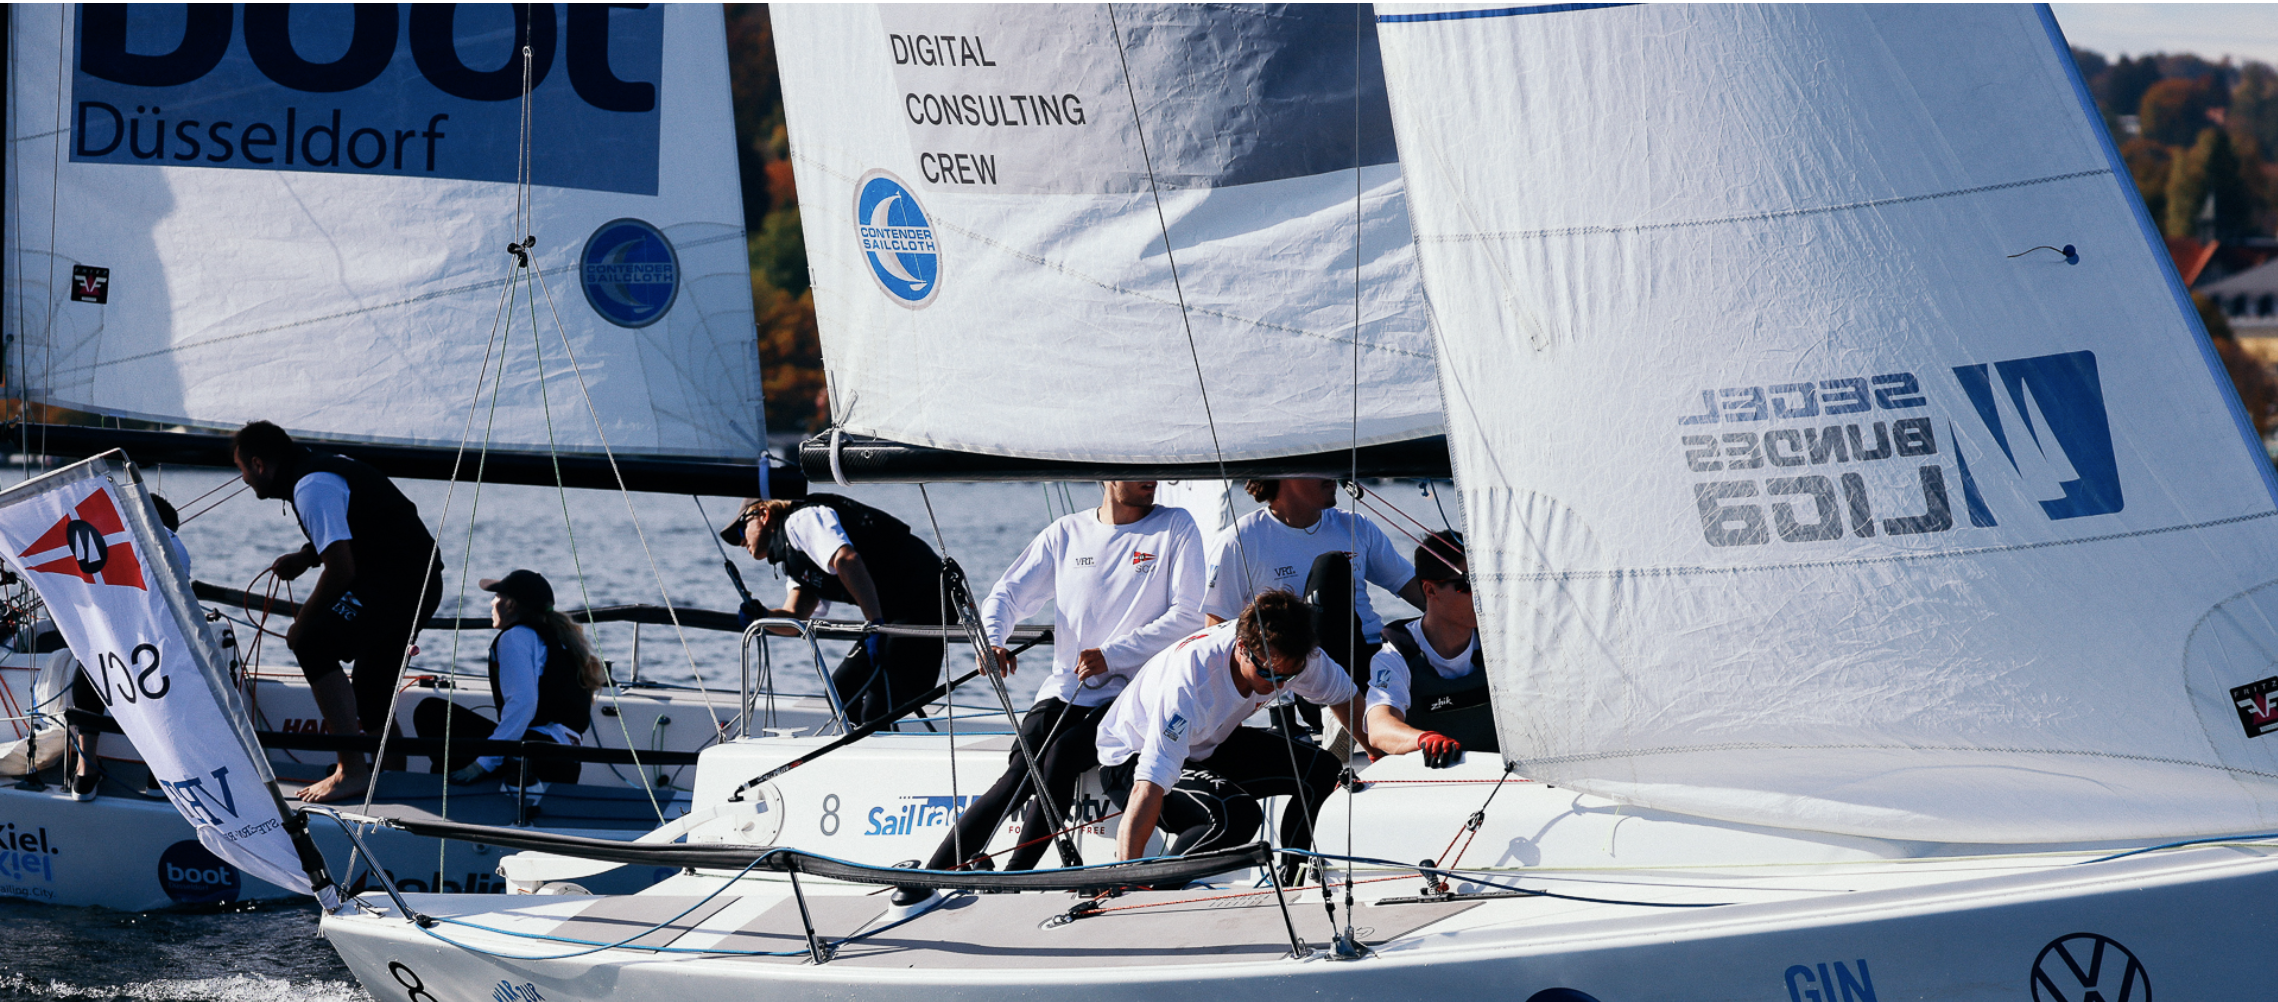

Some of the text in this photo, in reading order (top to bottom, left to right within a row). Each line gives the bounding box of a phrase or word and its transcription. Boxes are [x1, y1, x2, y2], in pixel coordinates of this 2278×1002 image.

[889, 34, 997, 66] DIGITAL
[905, 92, 1086, 126] CONSULTING
[76, 101, 449, 171] Düsseldorf
[920, 152, 997, 185] CREW
[860, 227, 933, 239] CONTENDER
[863, 239, 936, 251] SAILCLOTH
[586, 264, 673, 273] CONTENDER
[587, 273, 673, 283] SAILCLOTH
[2233, 680, 2278, 698] FRITZ
[820, 793, 840, 836] 8
[1080, 826, 1106, 835] FREE
[166, 862, 232, 886] boot
[388, 961, 438, 1002] 8
[1784, 959, 1878, 1002] GIN
